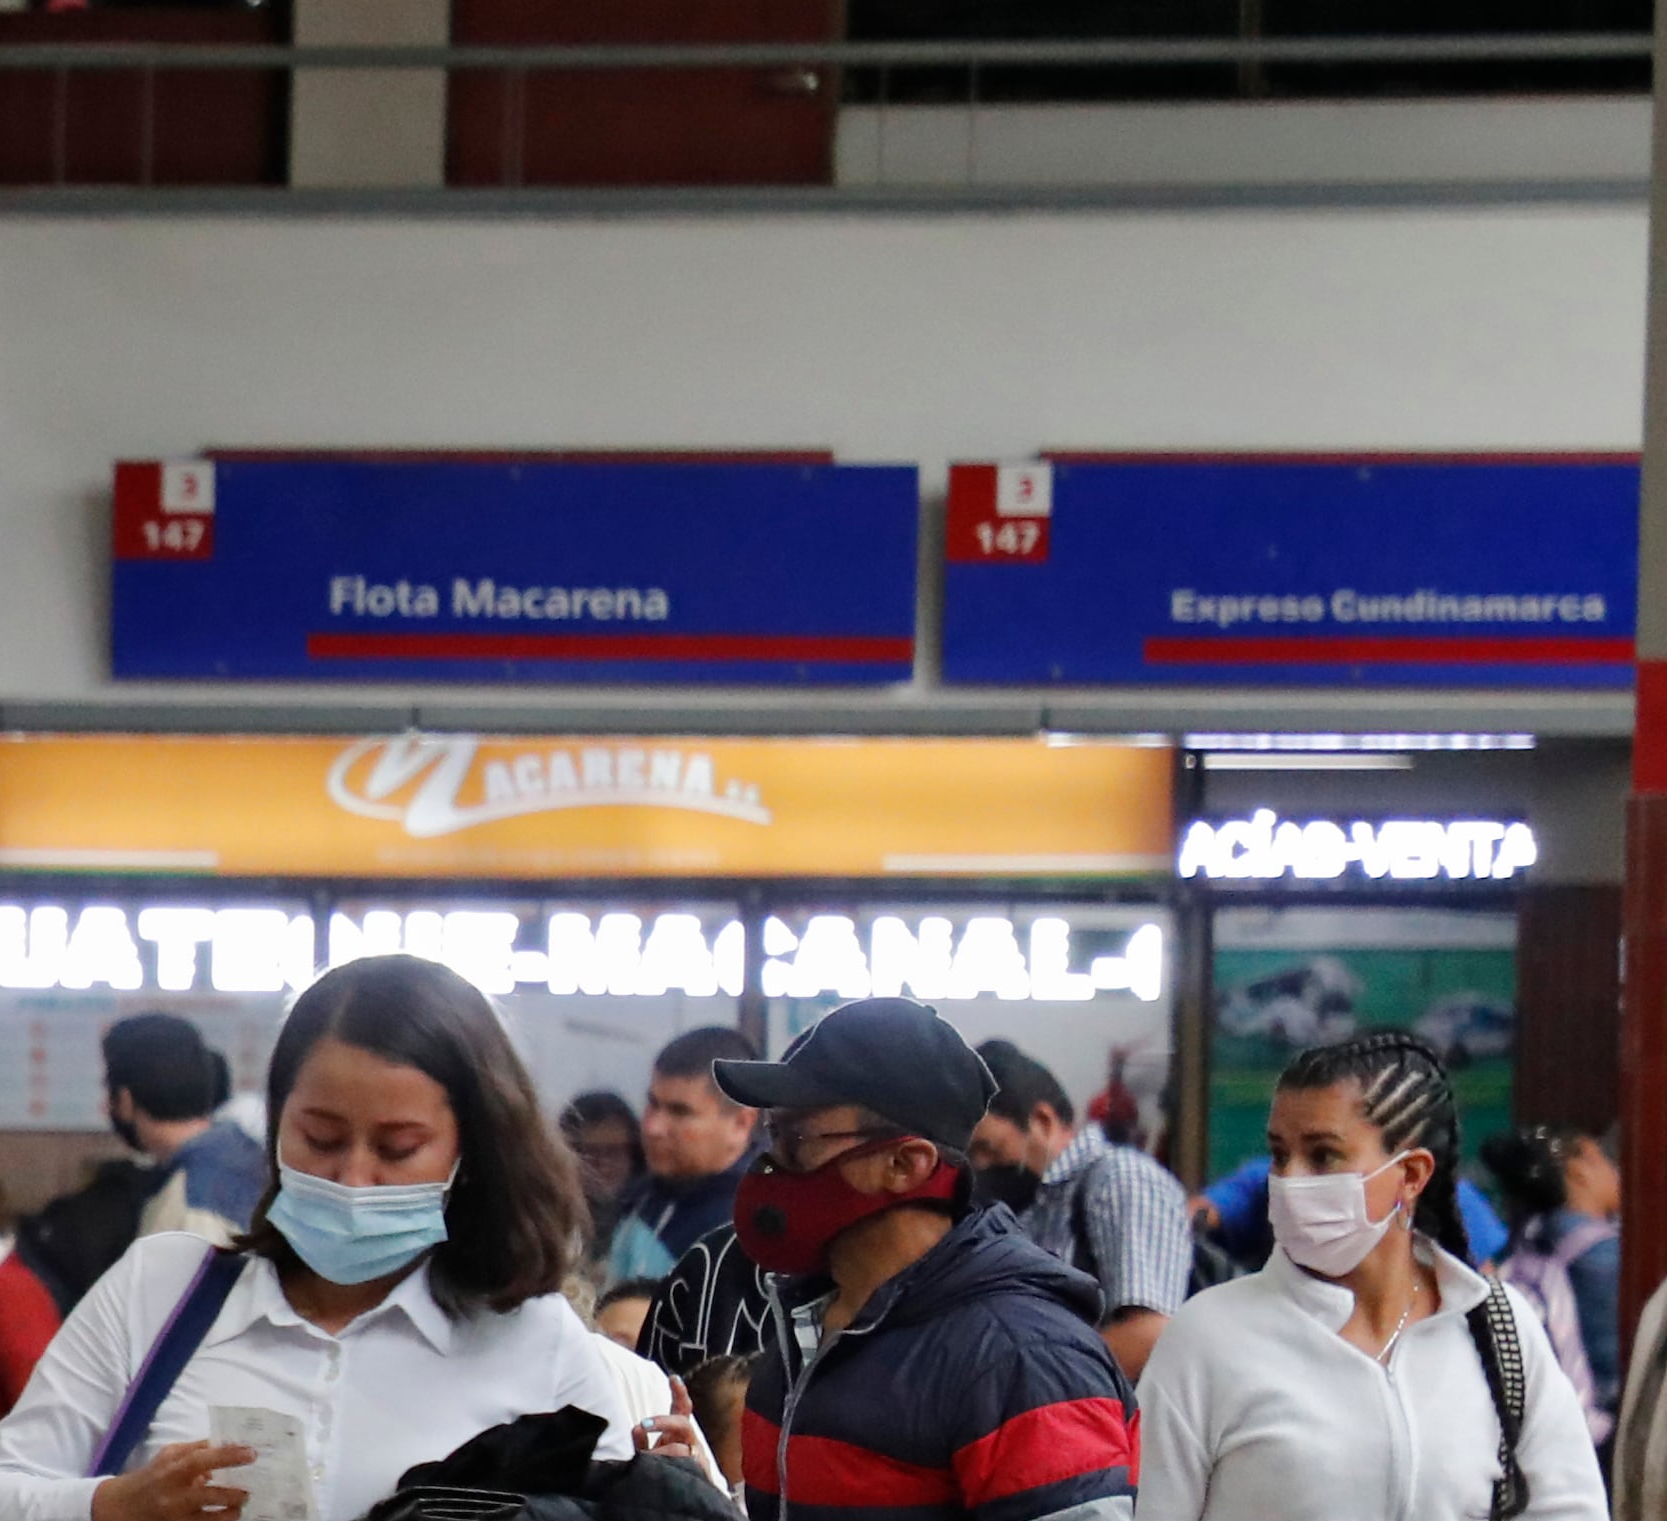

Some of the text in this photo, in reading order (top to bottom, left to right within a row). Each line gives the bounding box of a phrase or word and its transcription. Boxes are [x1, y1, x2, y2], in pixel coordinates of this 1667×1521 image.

[144, 519, 207, 552] 147
[976, 520, 1041, 554] 147
[329, 575, 669, 621] Flota Macarena
[1170, 586, 1607, 629] Expreso Cundinamarca
